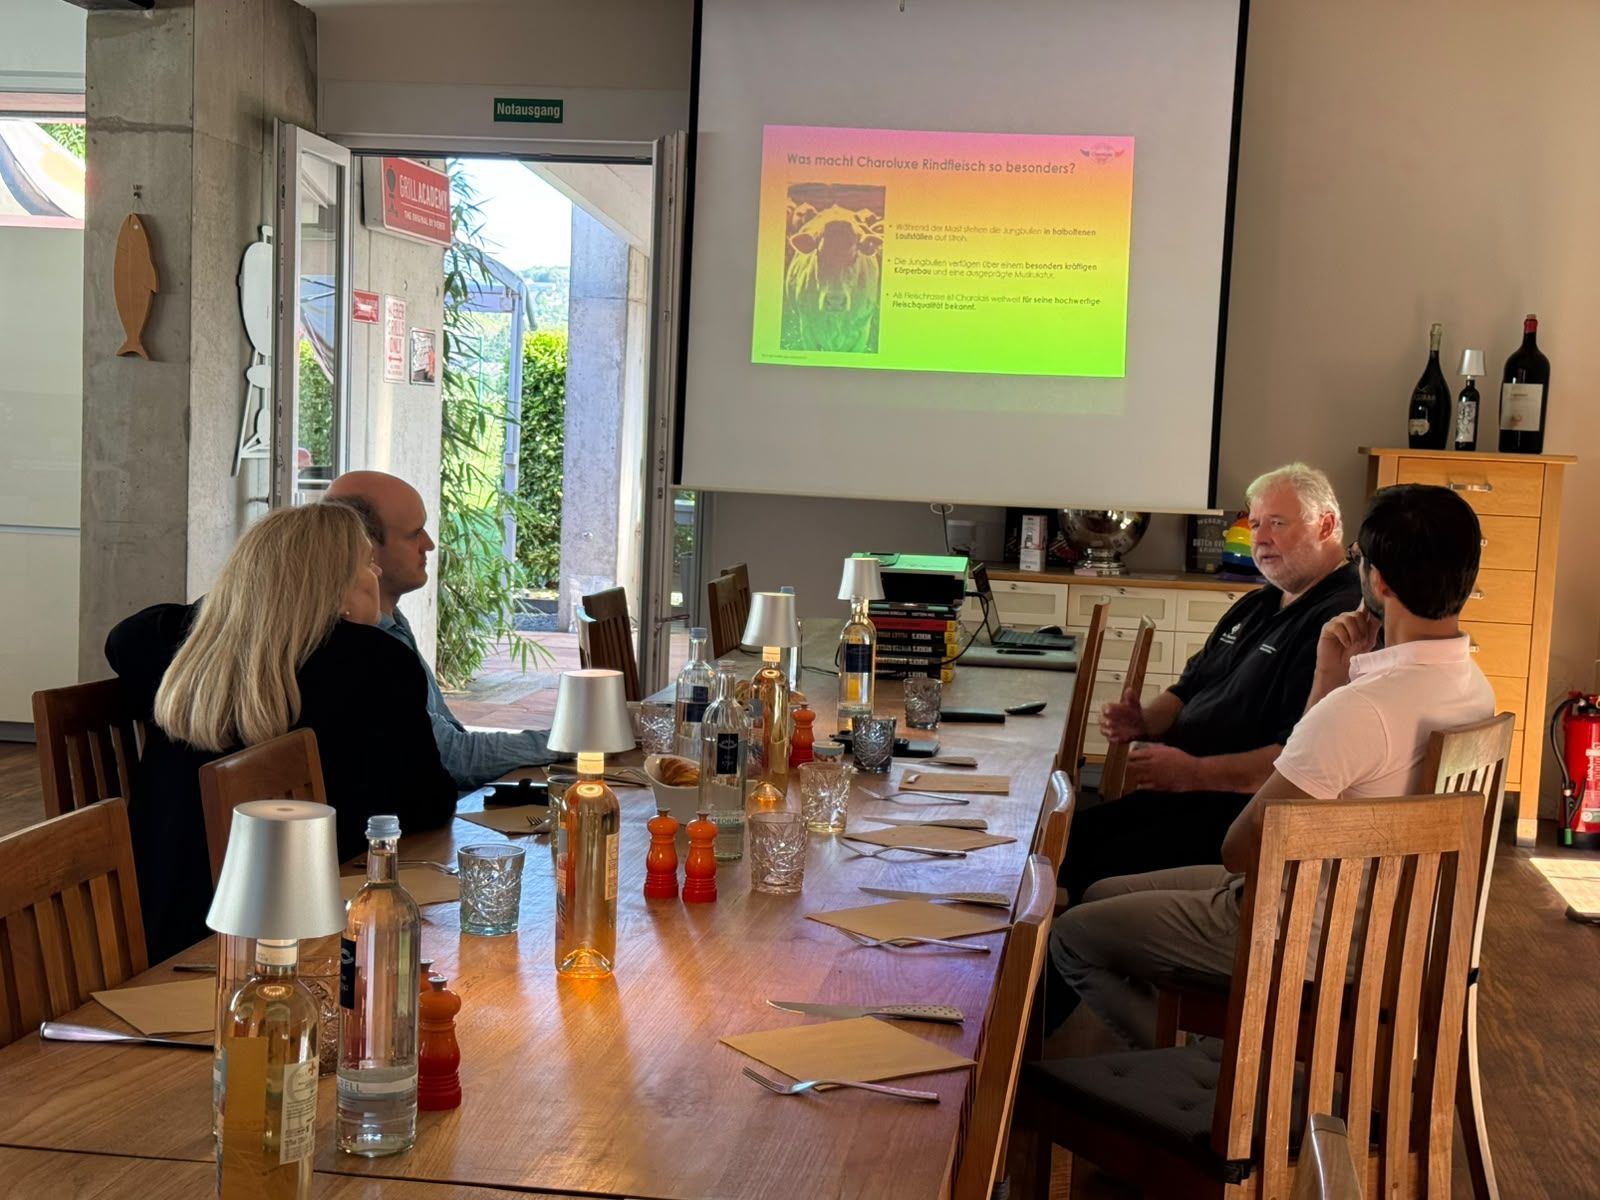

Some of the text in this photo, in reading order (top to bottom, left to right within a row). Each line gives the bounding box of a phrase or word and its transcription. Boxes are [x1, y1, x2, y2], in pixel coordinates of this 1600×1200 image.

[496, 102, 561, 119] Notausgang
[786, 153, 1076, 175] Was macht Charoluxe Rindfleisch so besonders?
[400, 174, 447, 211] GRILL ACADEMY
[1025, 261, 1063, 270] besonders
[1065, 262, 1098, 272] kräftigen
